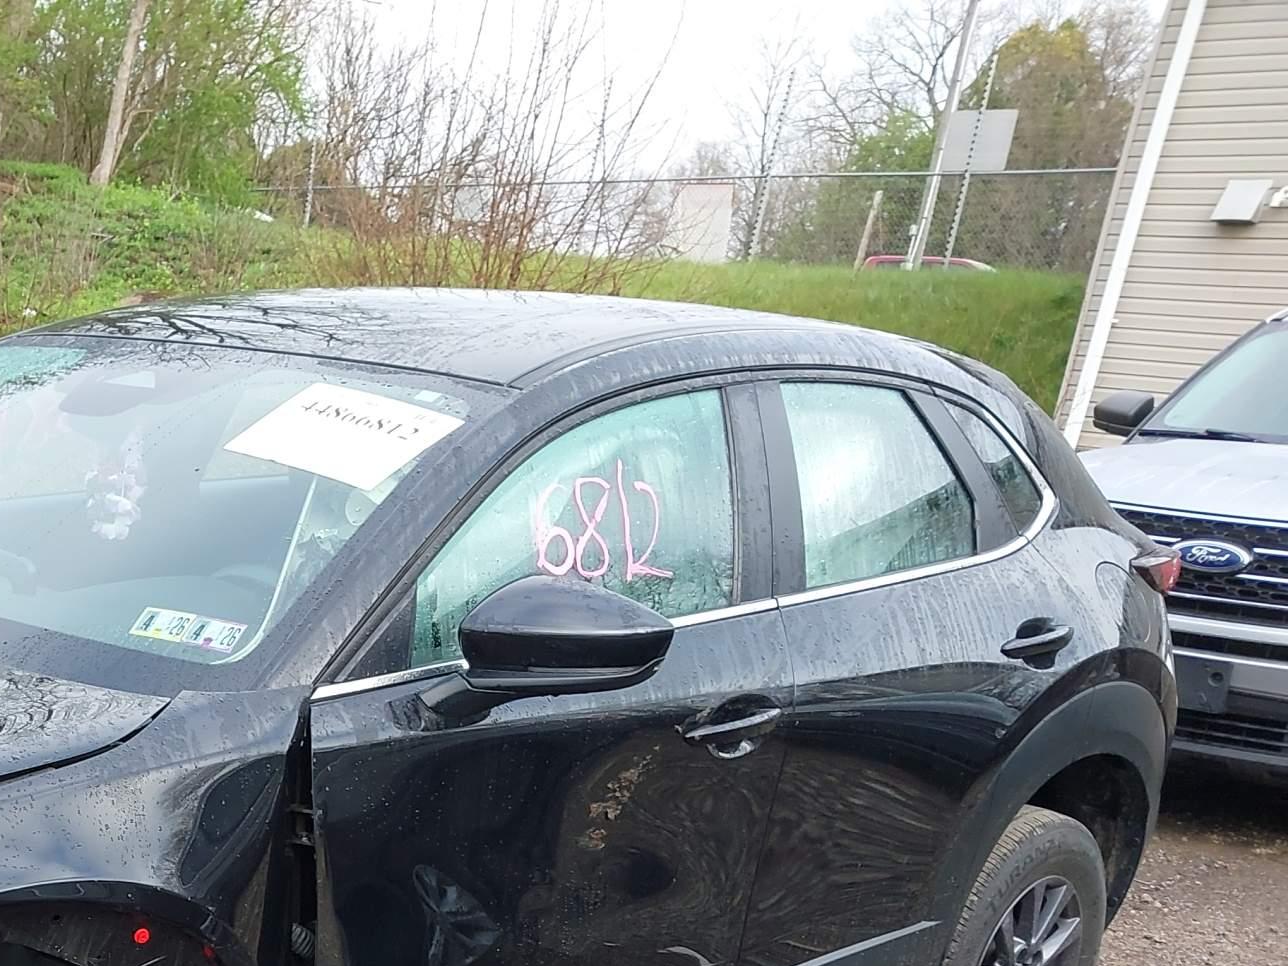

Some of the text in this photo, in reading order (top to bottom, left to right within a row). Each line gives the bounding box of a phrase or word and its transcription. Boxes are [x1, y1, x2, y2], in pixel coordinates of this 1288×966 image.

[300, 401, 420, 440] 44866812
[1187, 546, 1230, 563] Ford
[141, 615, 155, 631] 4
[192, 624, 241, 647] 4 26
